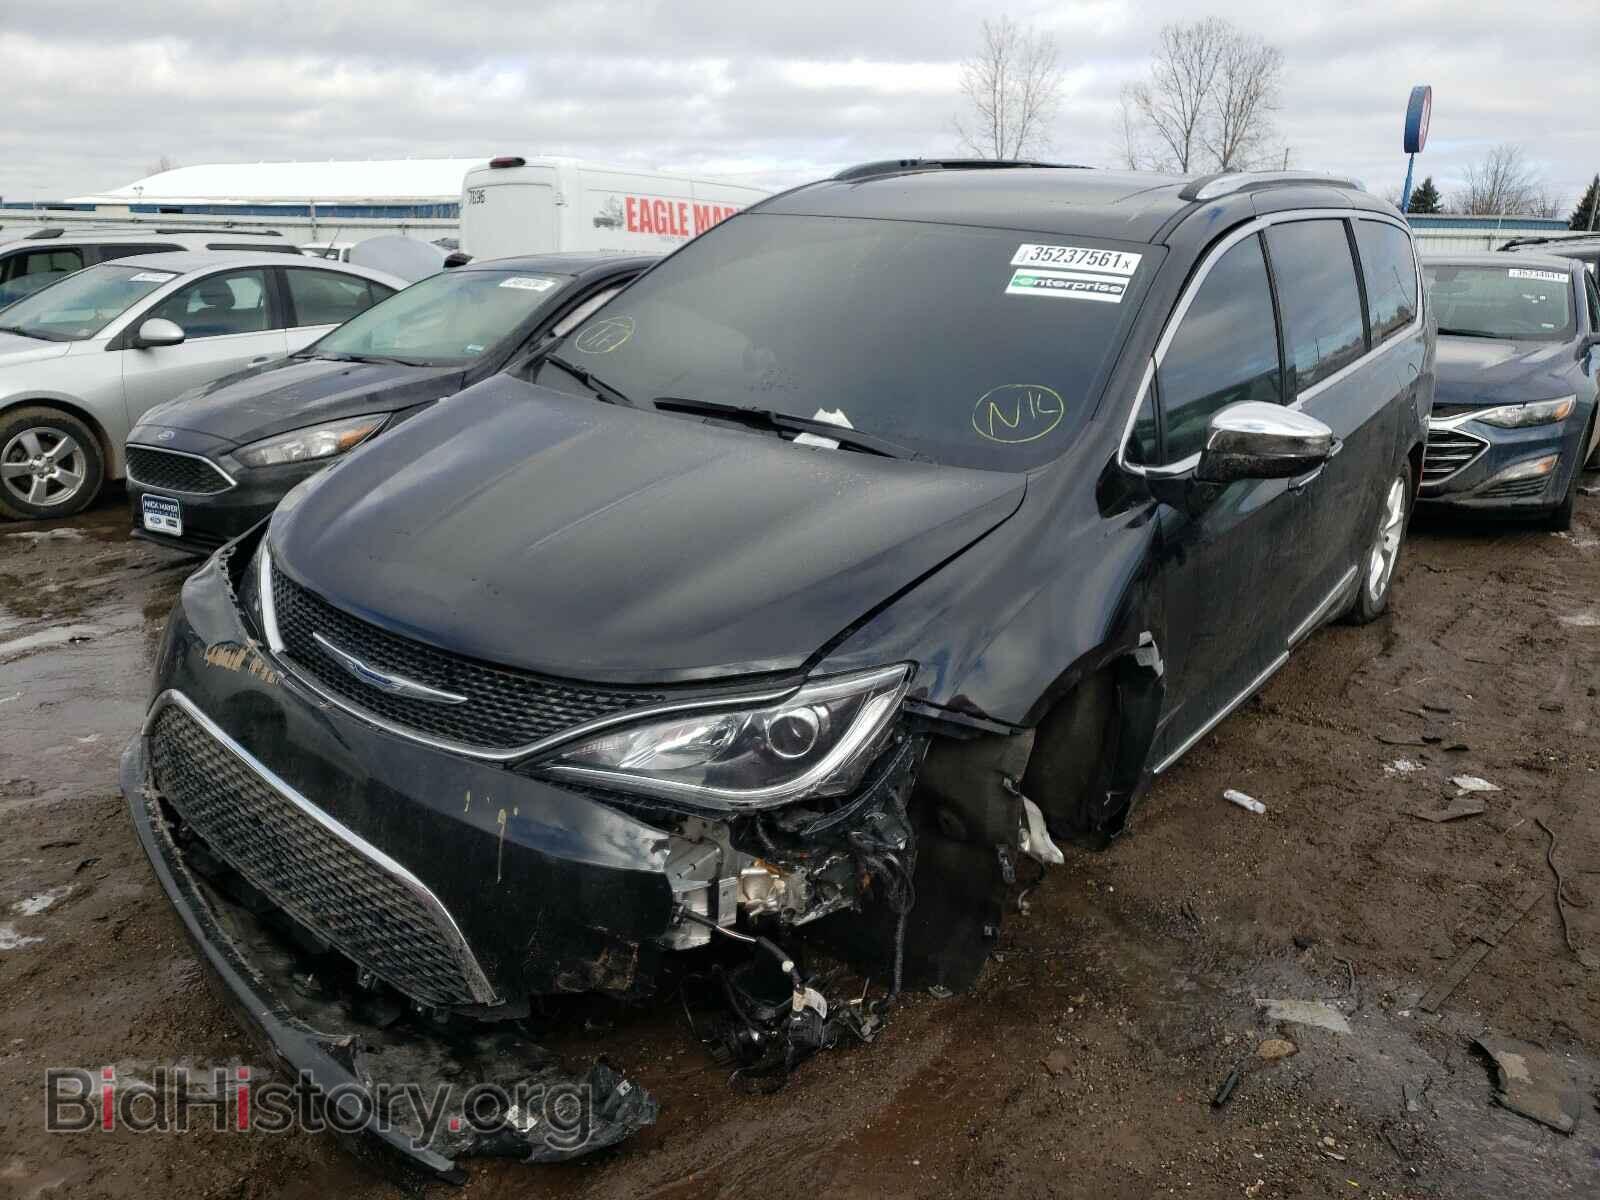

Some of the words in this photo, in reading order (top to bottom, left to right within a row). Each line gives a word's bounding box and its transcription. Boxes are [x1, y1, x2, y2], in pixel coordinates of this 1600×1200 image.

[624, 196, 688, 237] EAGLE
[692, 203, 743, 236] MA
[1029, 246, 1122, 269] 35237561
[1014, 276, 1123, 293] enterprise
